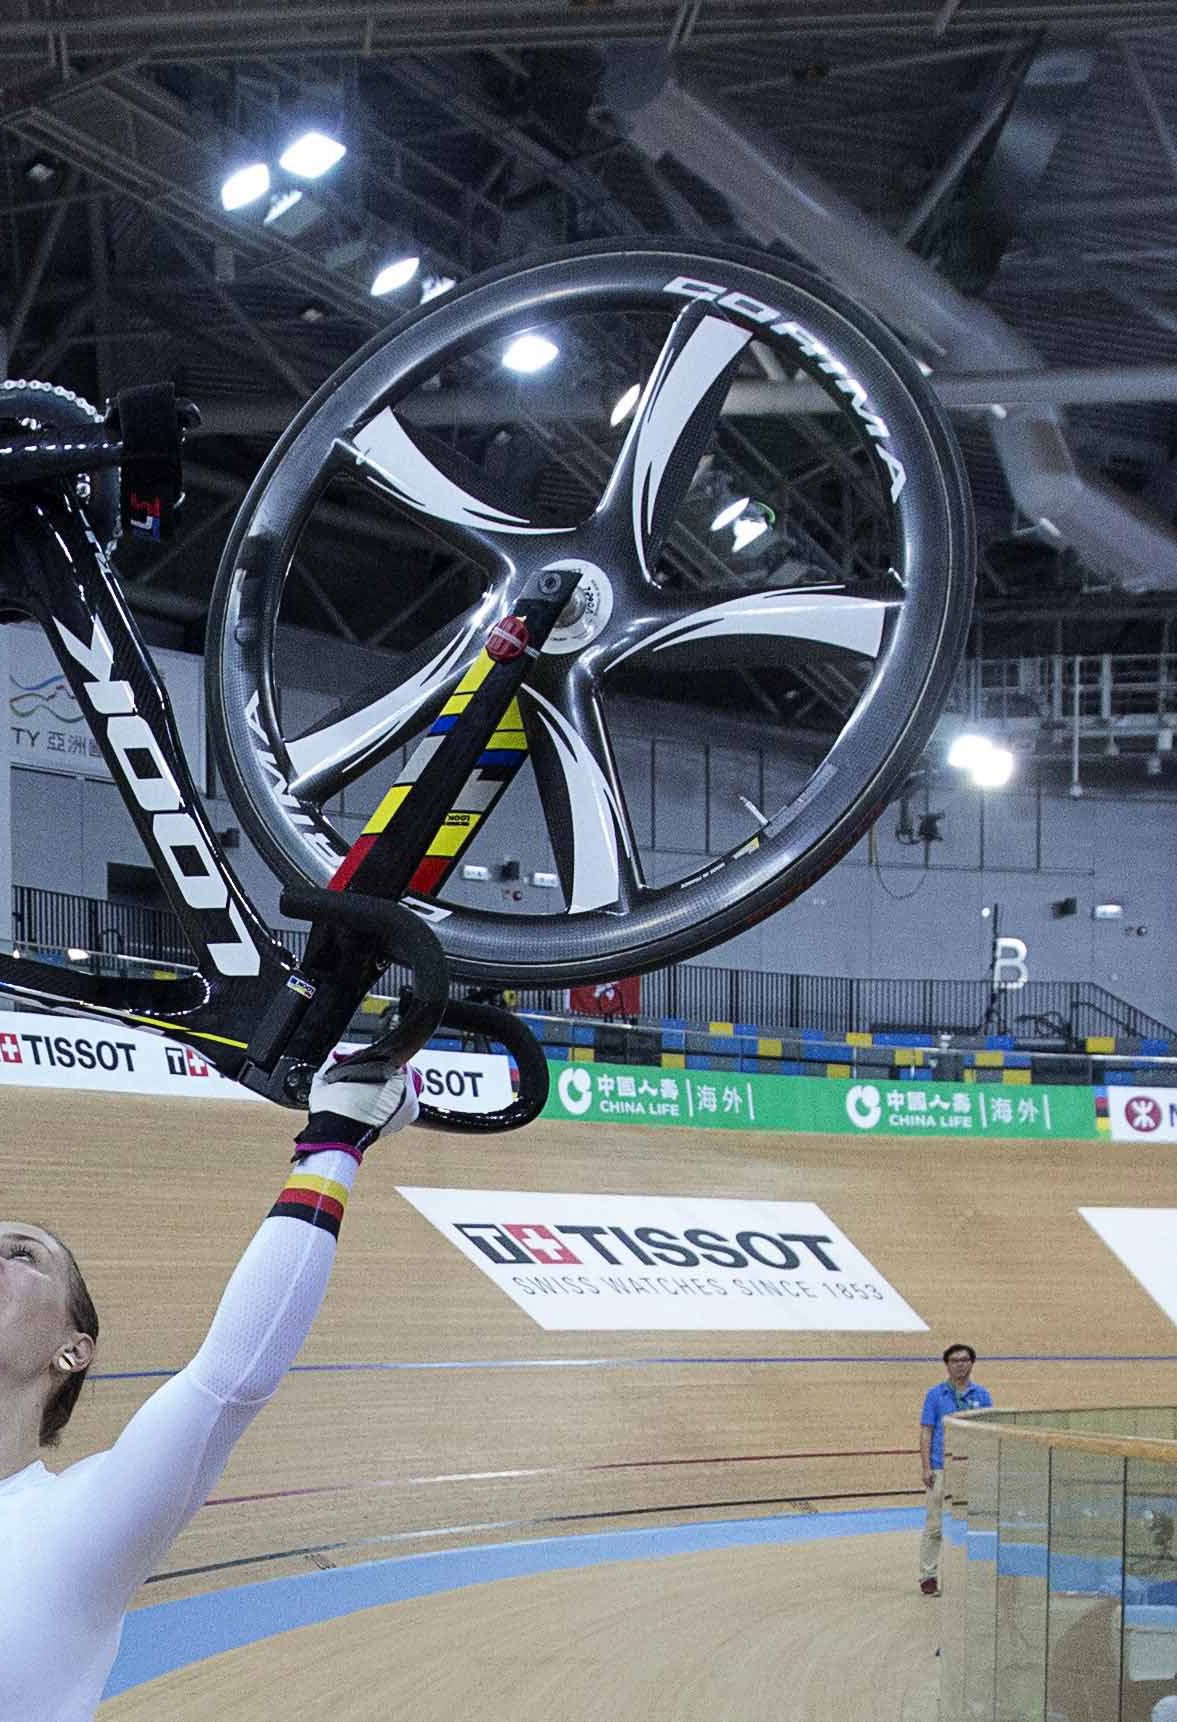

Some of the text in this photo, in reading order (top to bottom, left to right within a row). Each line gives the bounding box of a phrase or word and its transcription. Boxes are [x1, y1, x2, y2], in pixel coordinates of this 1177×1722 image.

[663, 274, 906, 504] CORIMA
[52, 613, 261, 977] LOOK
[244, 689, 453, 922] CRIMA
[993, 937, 1028, 991] B
[21, 1034, 137, 1072] TISSOT
[599, 1099, 681, 1117] CHINA LIFE
[696, 1084, 744, 1114] 海外
[991, 1098, 1040, 1124] 海外
[889, 1113, 973, 1129] CHINA LIFE
[554, 1225, 842, 1272] TISSOT
[511, 1276, 885, 1301] SWISS WATCHES SINCE 1853
